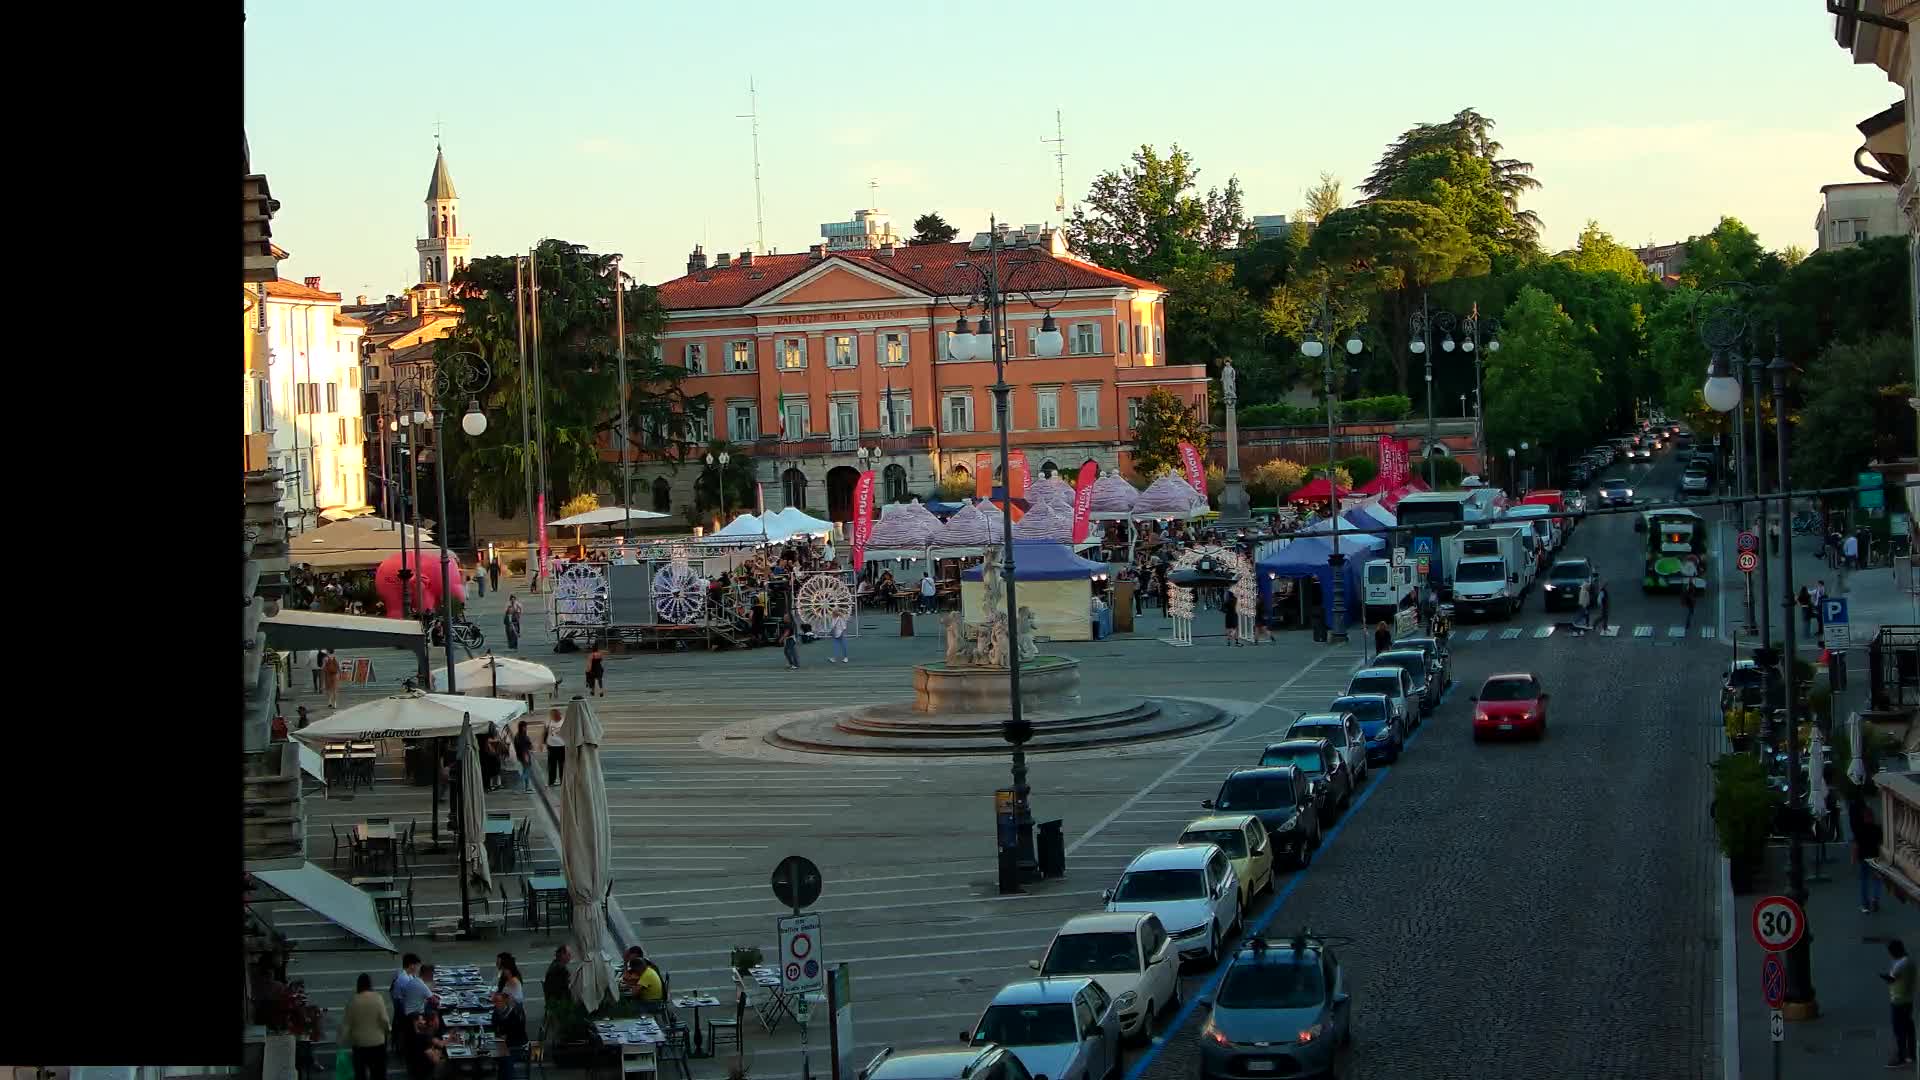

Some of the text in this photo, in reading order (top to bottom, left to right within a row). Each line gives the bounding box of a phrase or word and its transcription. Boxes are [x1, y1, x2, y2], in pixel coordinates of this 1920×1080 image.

[777, 310, 903, 325] PALAZZO DEL GOVERNO
[859, 478, 871, 515] PUGLIA
[1742, 557, 1753, 566] 20
[1827, 601, 1842, 621] P
[1762, 910, 1792, 937] 30
